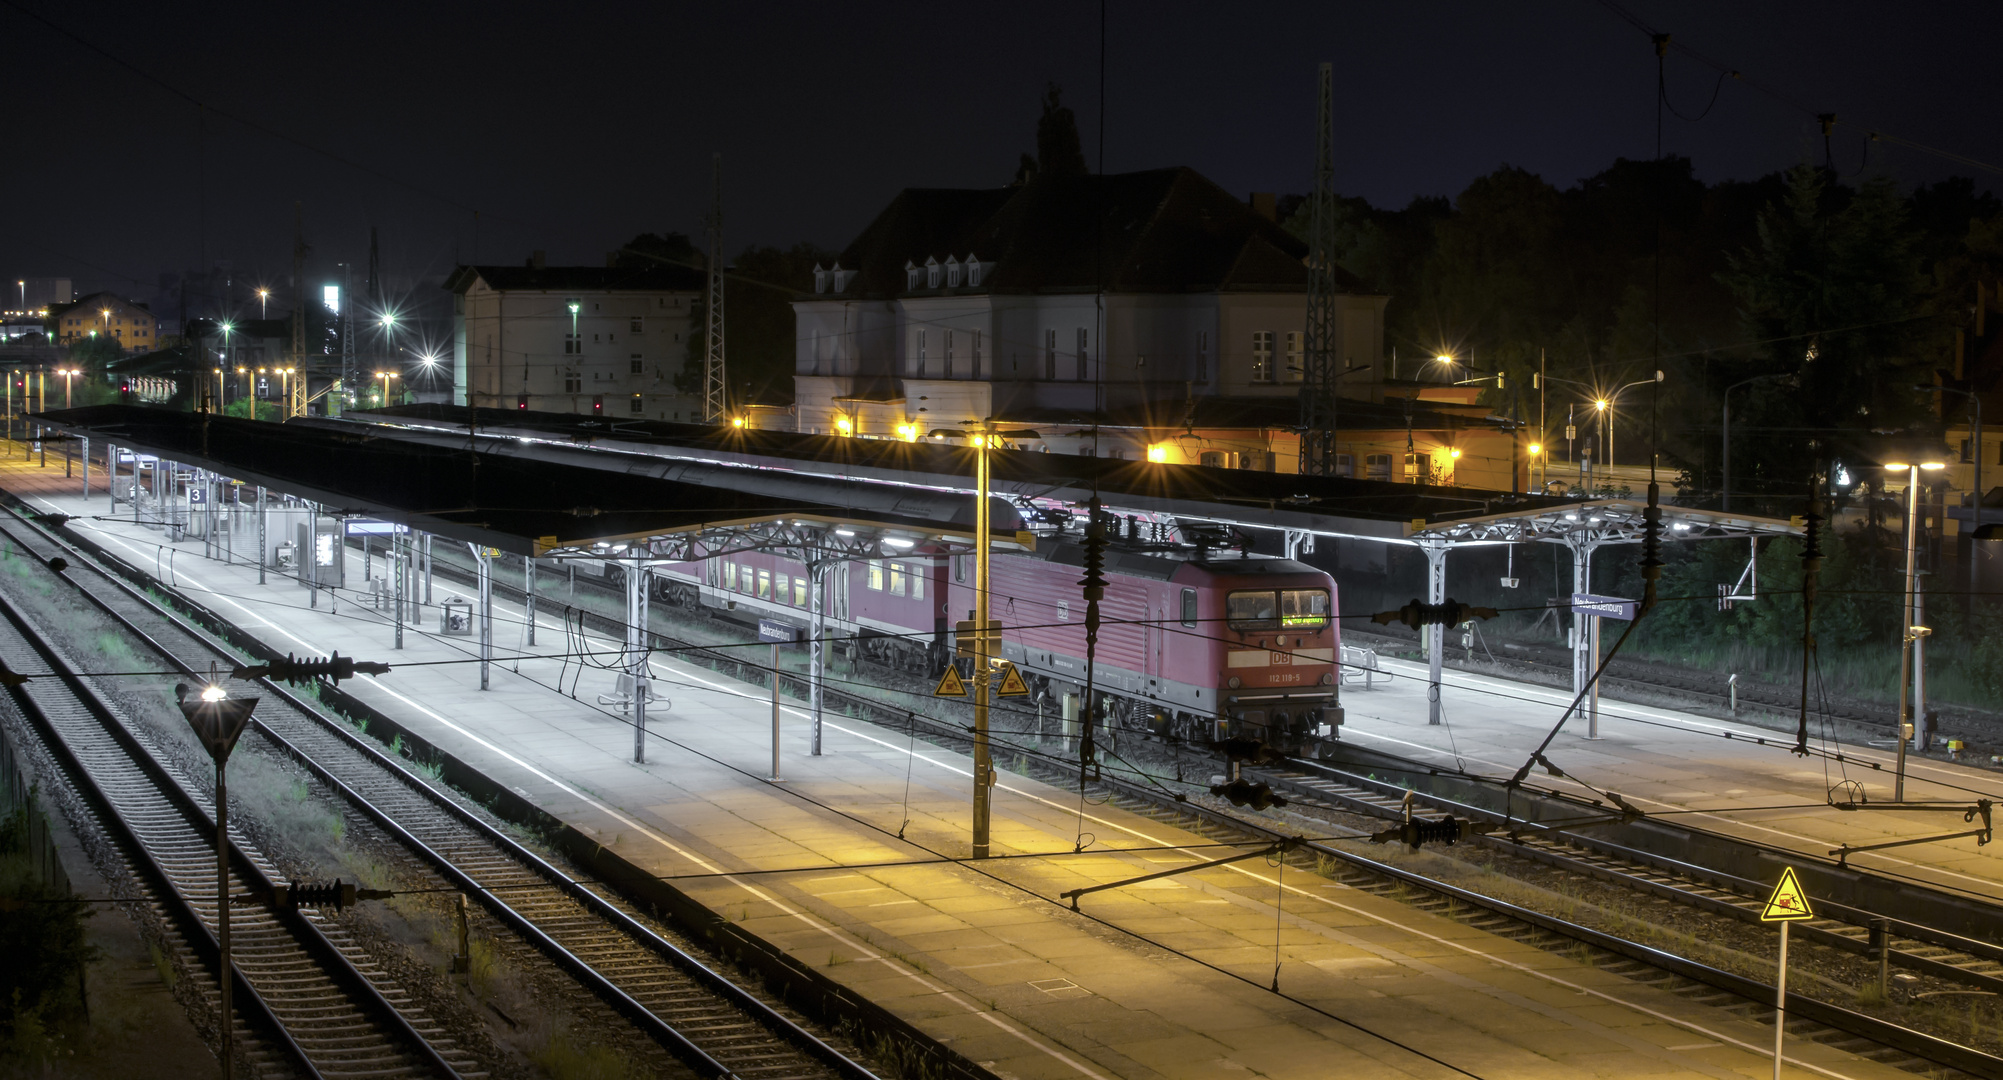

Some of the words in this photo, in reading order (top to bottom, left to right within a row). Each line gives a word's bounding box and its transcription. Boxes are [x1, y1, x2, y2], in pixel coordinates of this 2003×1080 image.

[192, 489, 200, 501] 3
[1574, 596, 1623, 616] Neubrandenburg
[760, 622, 790, 642] Neubrandenburg
[1272, 651, 1290, 665] DB
[1269, 674, 1280, 683] 112
